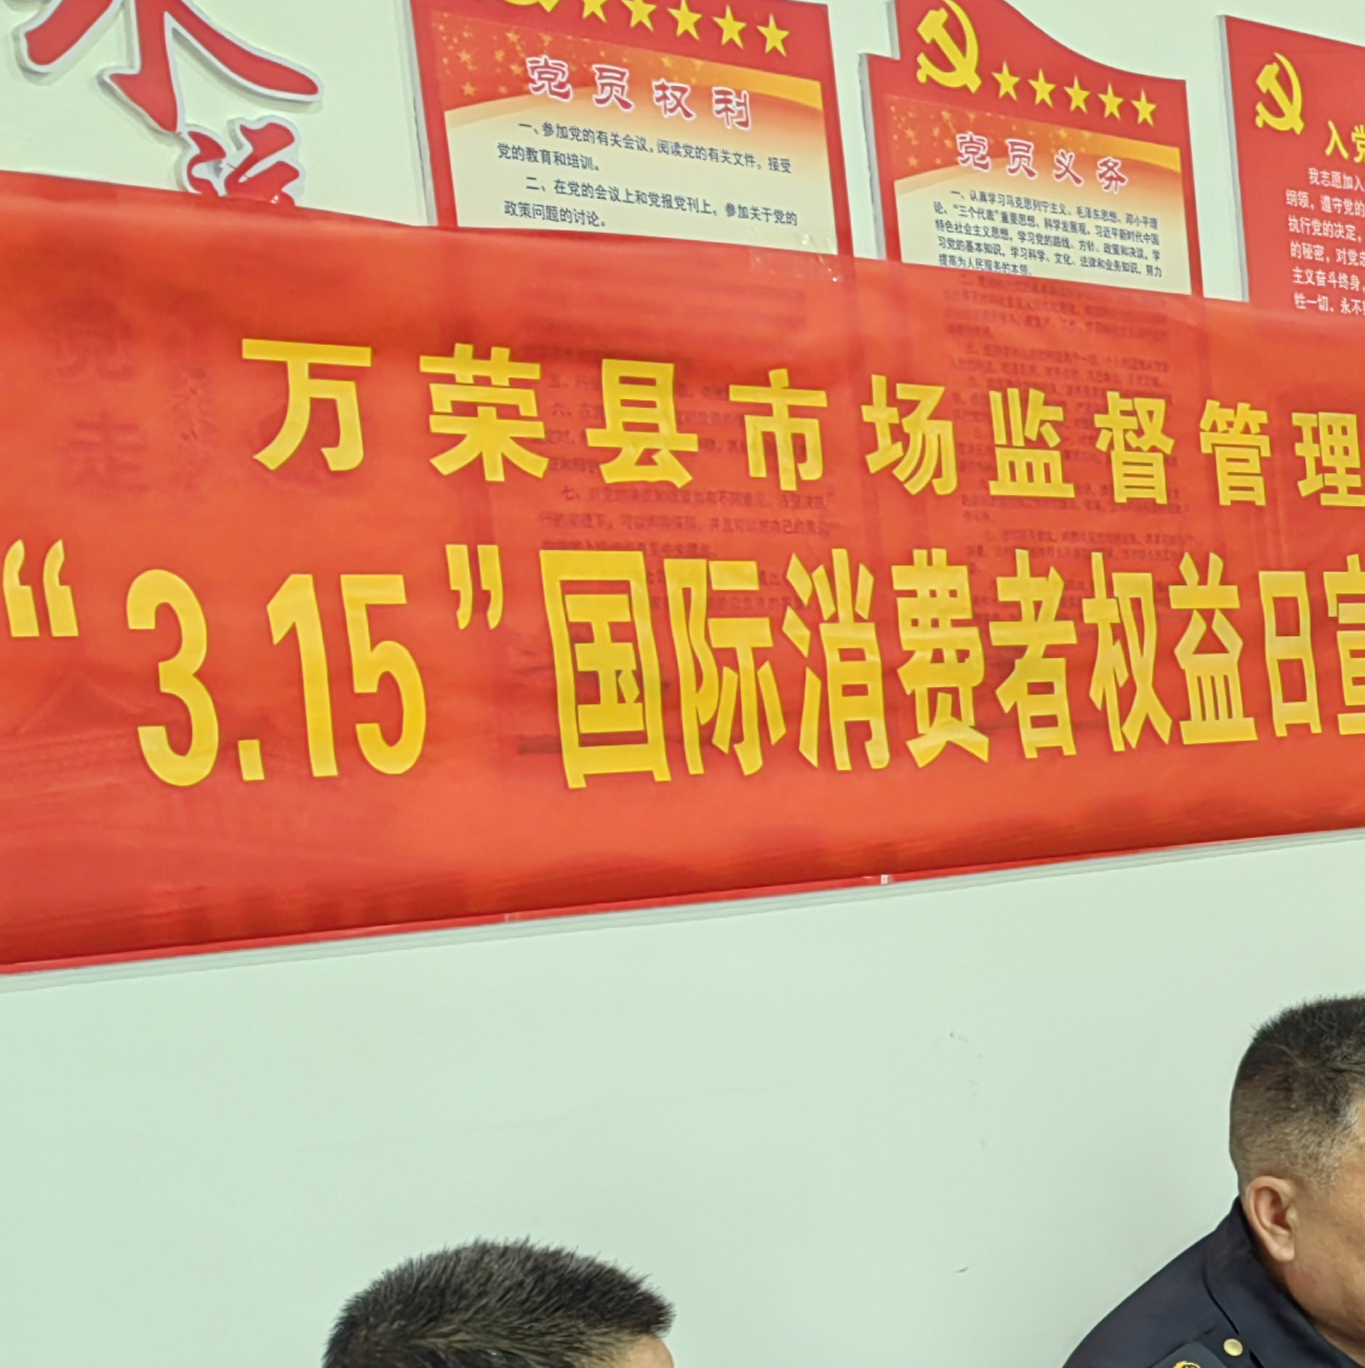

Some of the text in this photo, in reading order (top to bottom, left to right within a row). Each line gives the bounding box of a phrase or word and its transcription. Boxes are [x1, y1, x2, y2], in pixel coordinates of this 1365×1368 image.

[527, 55, 752, 131] 党员权利
[497, 143, 600, 172] 党的教育和培训。
[956, 132, 1128, 193] 党员义务
[503, 200, 607, 228] 政策问题的讨论。
